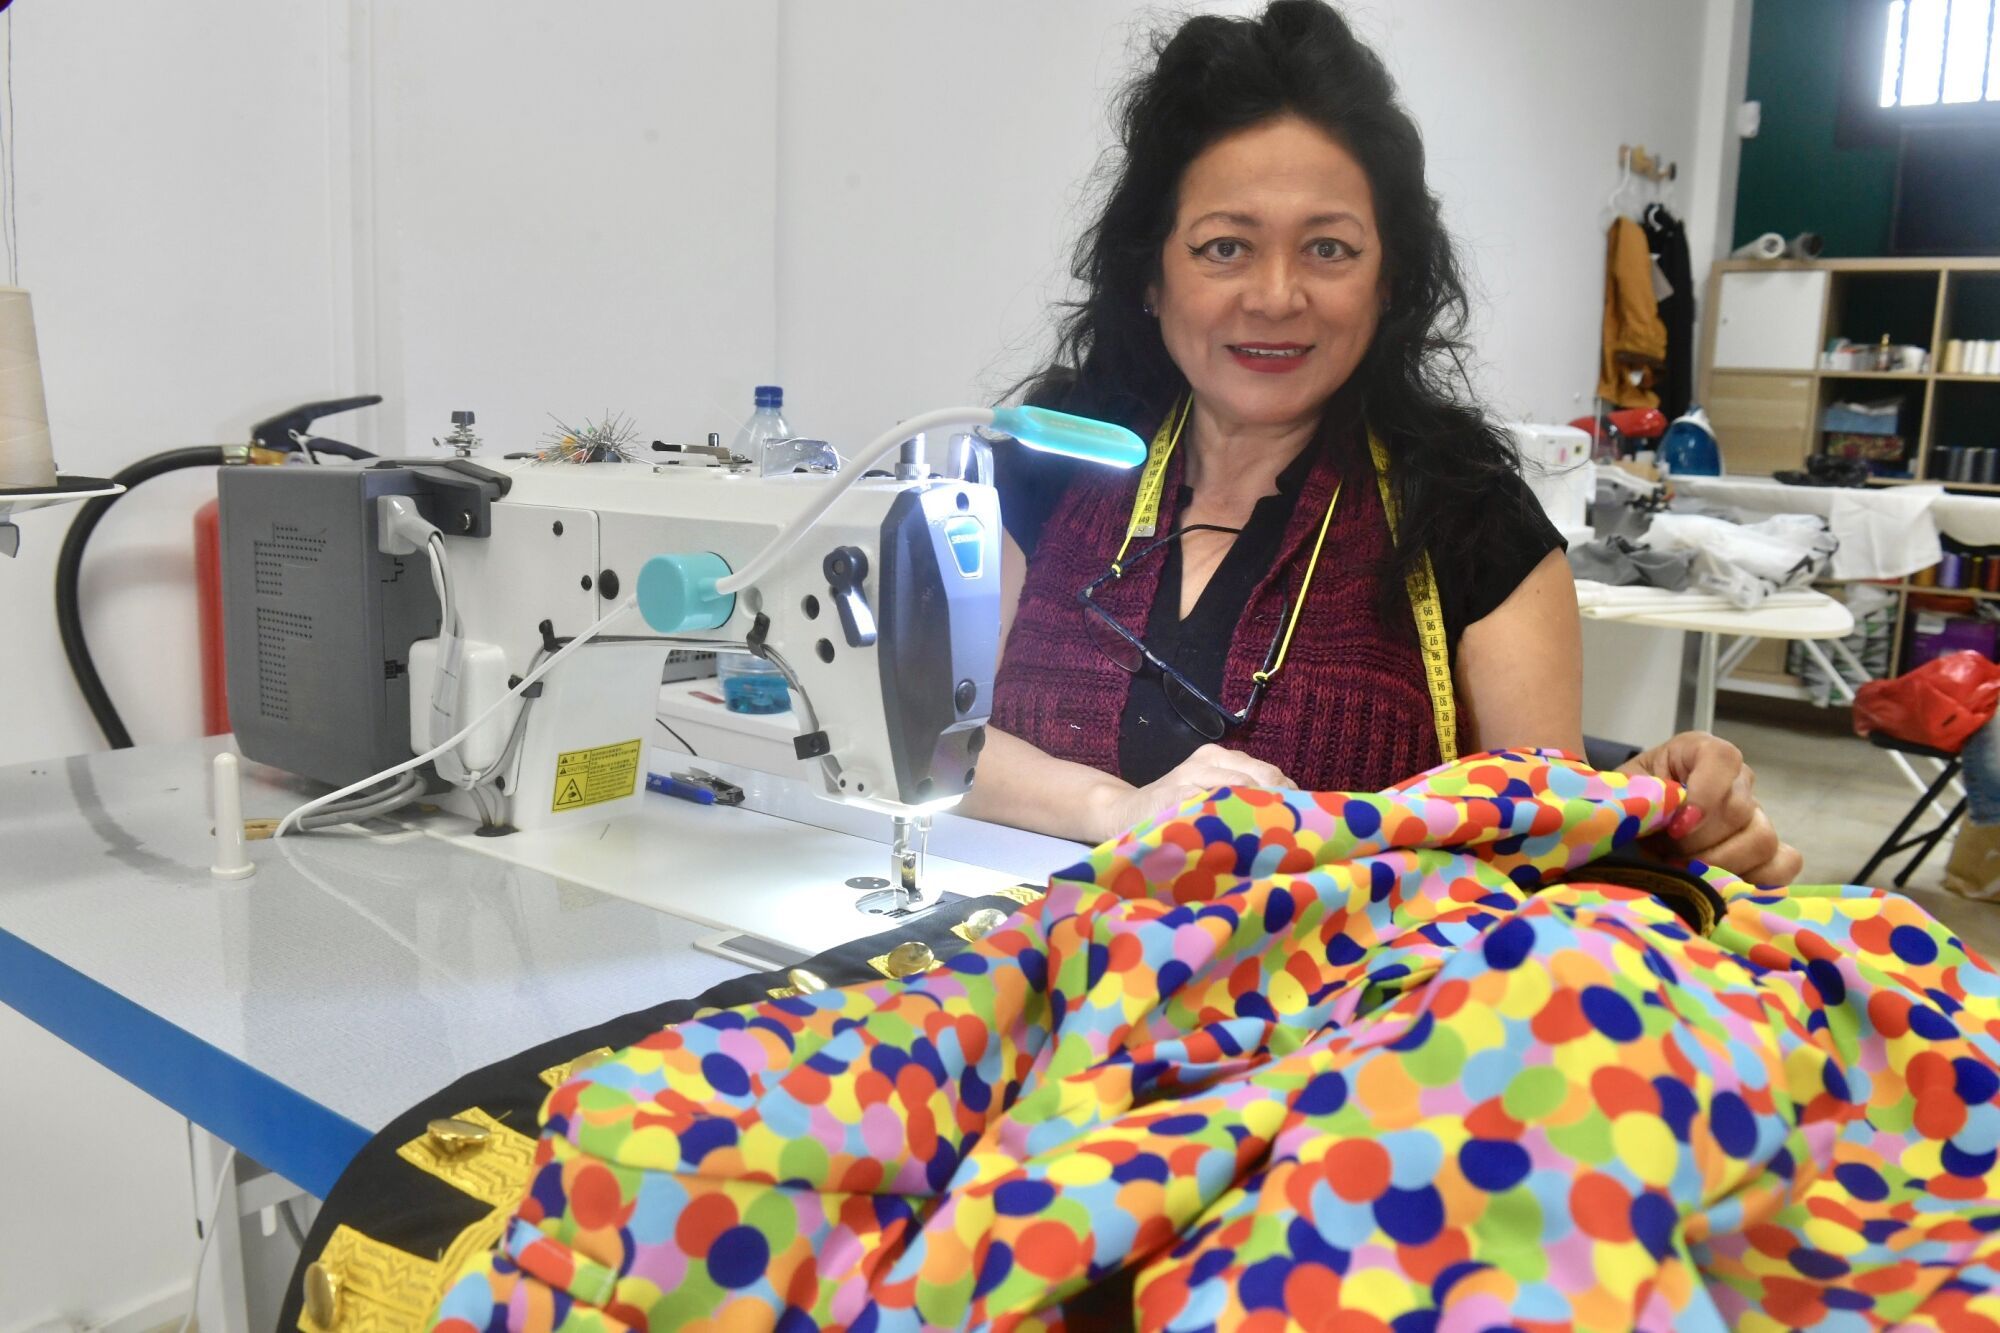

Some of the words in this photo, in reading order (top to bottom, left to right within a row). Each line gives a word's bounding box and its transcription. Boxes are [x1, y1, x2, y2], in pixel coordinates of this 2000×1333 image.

[1423, 606, 1433, 616] 99
[1426, 621, 1436, 631] 98
[1430, 636, 1438, 646] 97
[1431, 651, 1440, 661] 96
[1434, 666, 1443, 676] 95
[1437, 682, 1446, 691] 94
[1439, 696, 1447, 706] 93
[1442, 712, 1450, 721] 92
[1444, 727, 1450, 737] 91
